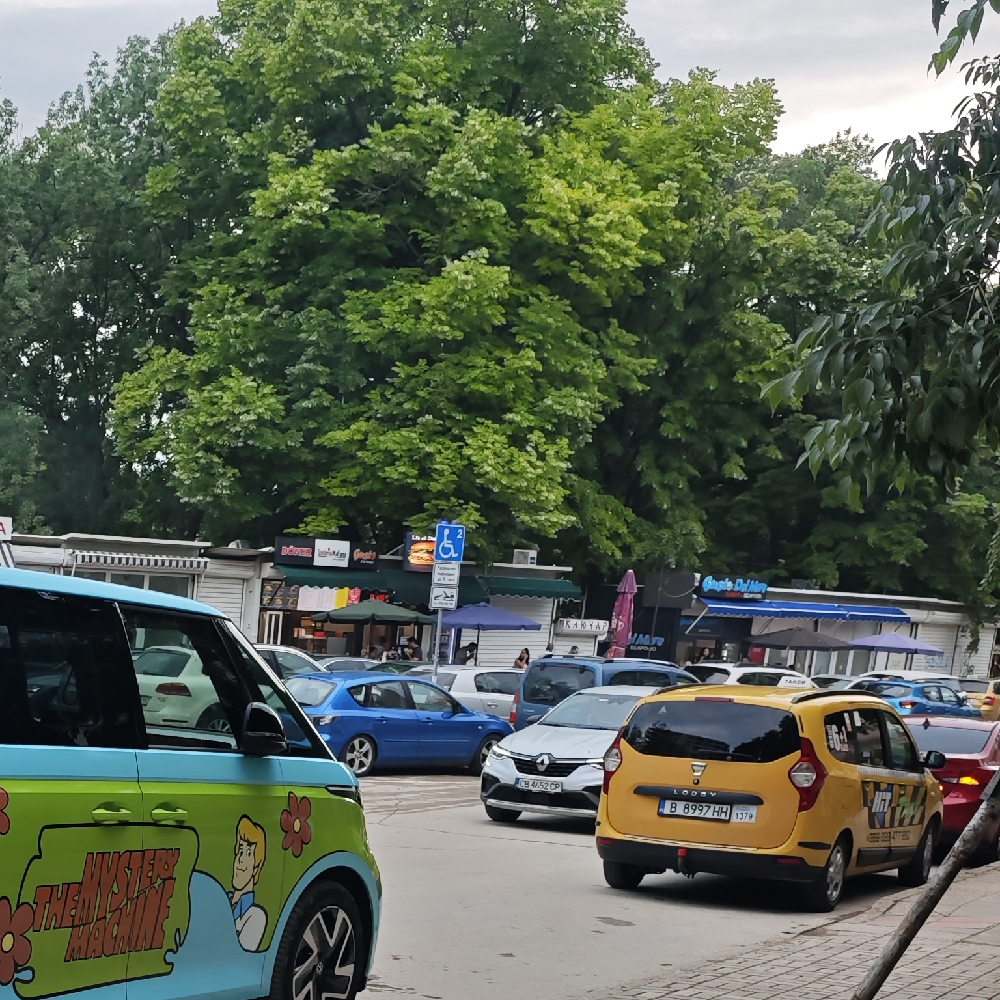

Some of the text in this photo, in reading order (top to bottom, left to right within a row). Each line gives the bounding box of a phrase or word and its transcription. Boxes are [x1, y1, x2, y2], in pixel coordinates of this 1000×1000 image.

[456, 529, 463, 539] 2
[281, 545, 313, 557] DÖNER
[669, 802, 677, 813] B
[683, 803, 711, 816] 8997
[712, 805, 729, 818] HH
[33, 848, 180, 932] THE MYSTERY
[64, 877, 177, 963] MACHINE
